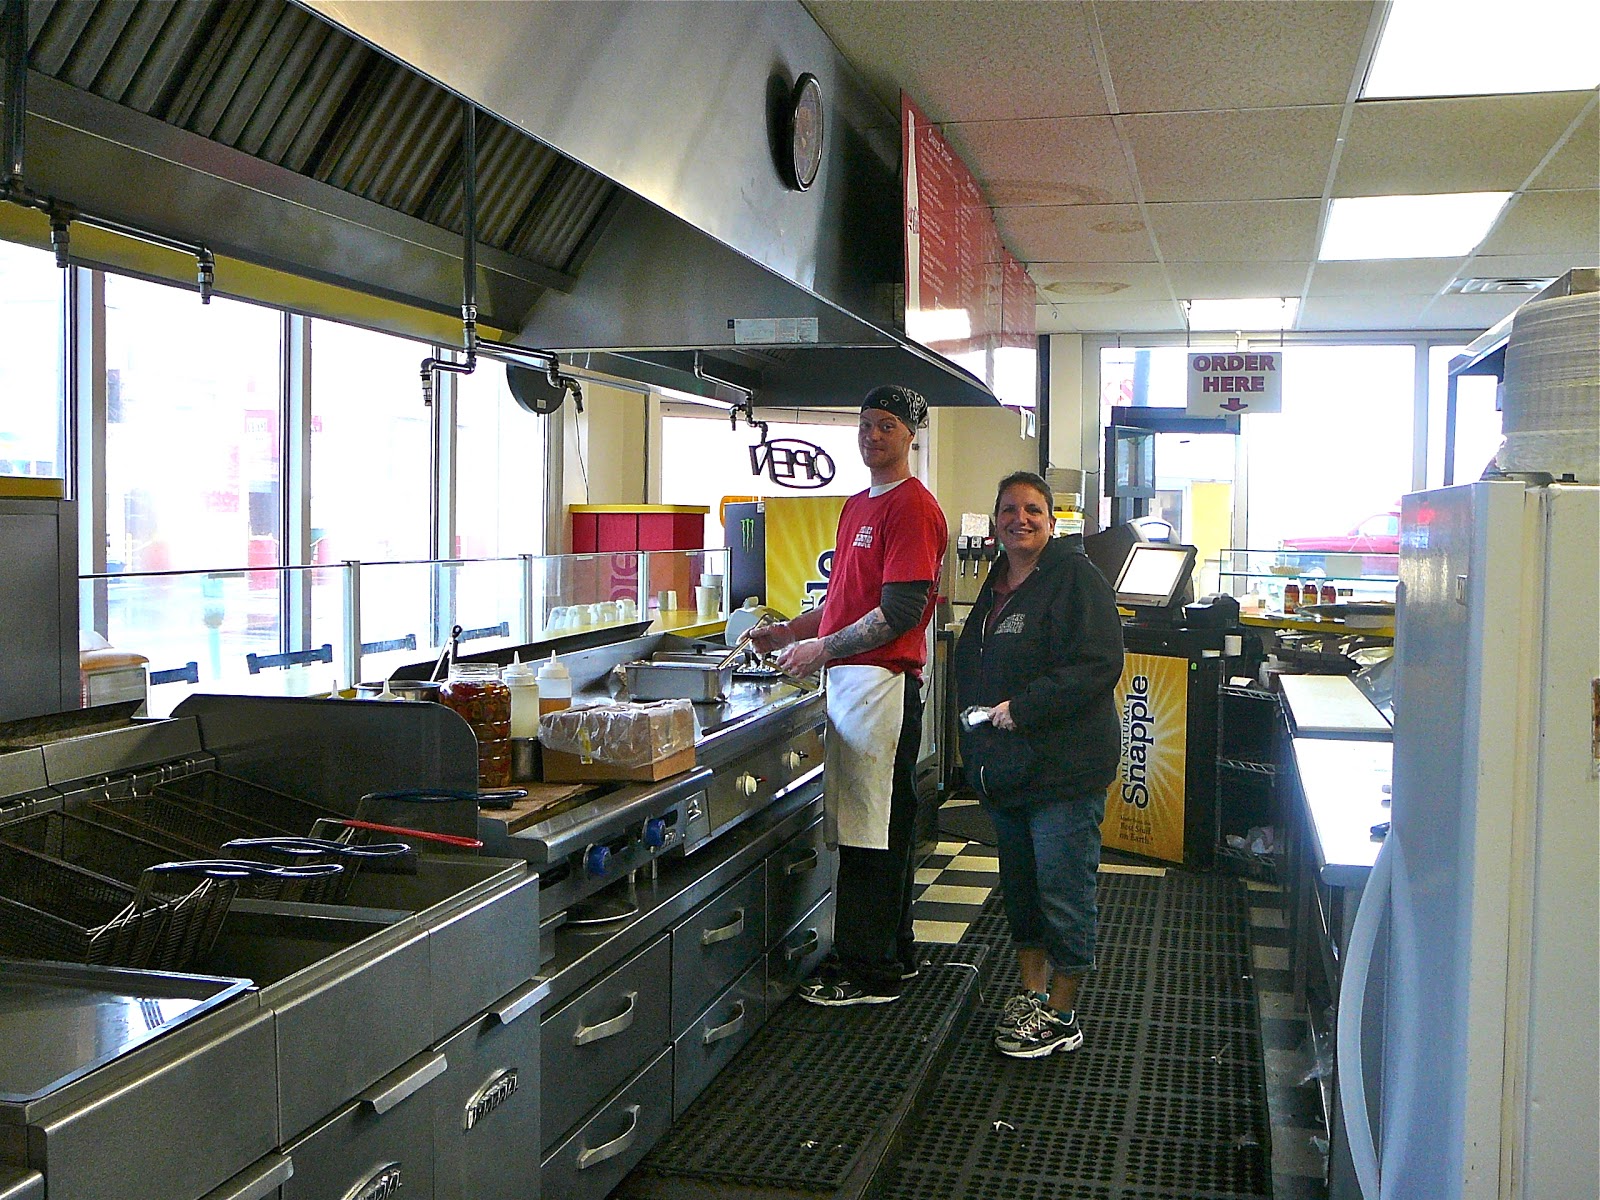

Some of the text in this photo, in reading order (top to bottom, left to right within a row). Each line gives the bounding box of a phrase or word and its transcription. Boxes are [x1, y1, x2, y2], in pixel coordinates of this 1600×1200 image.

[1193, 355, 1275, 372] ORDER
[1202, 376, 1265, 392] HERE
[1121, 704, 1131, 782] ALL NATURAL
[1122, 675, 1155, 809] Snapple
